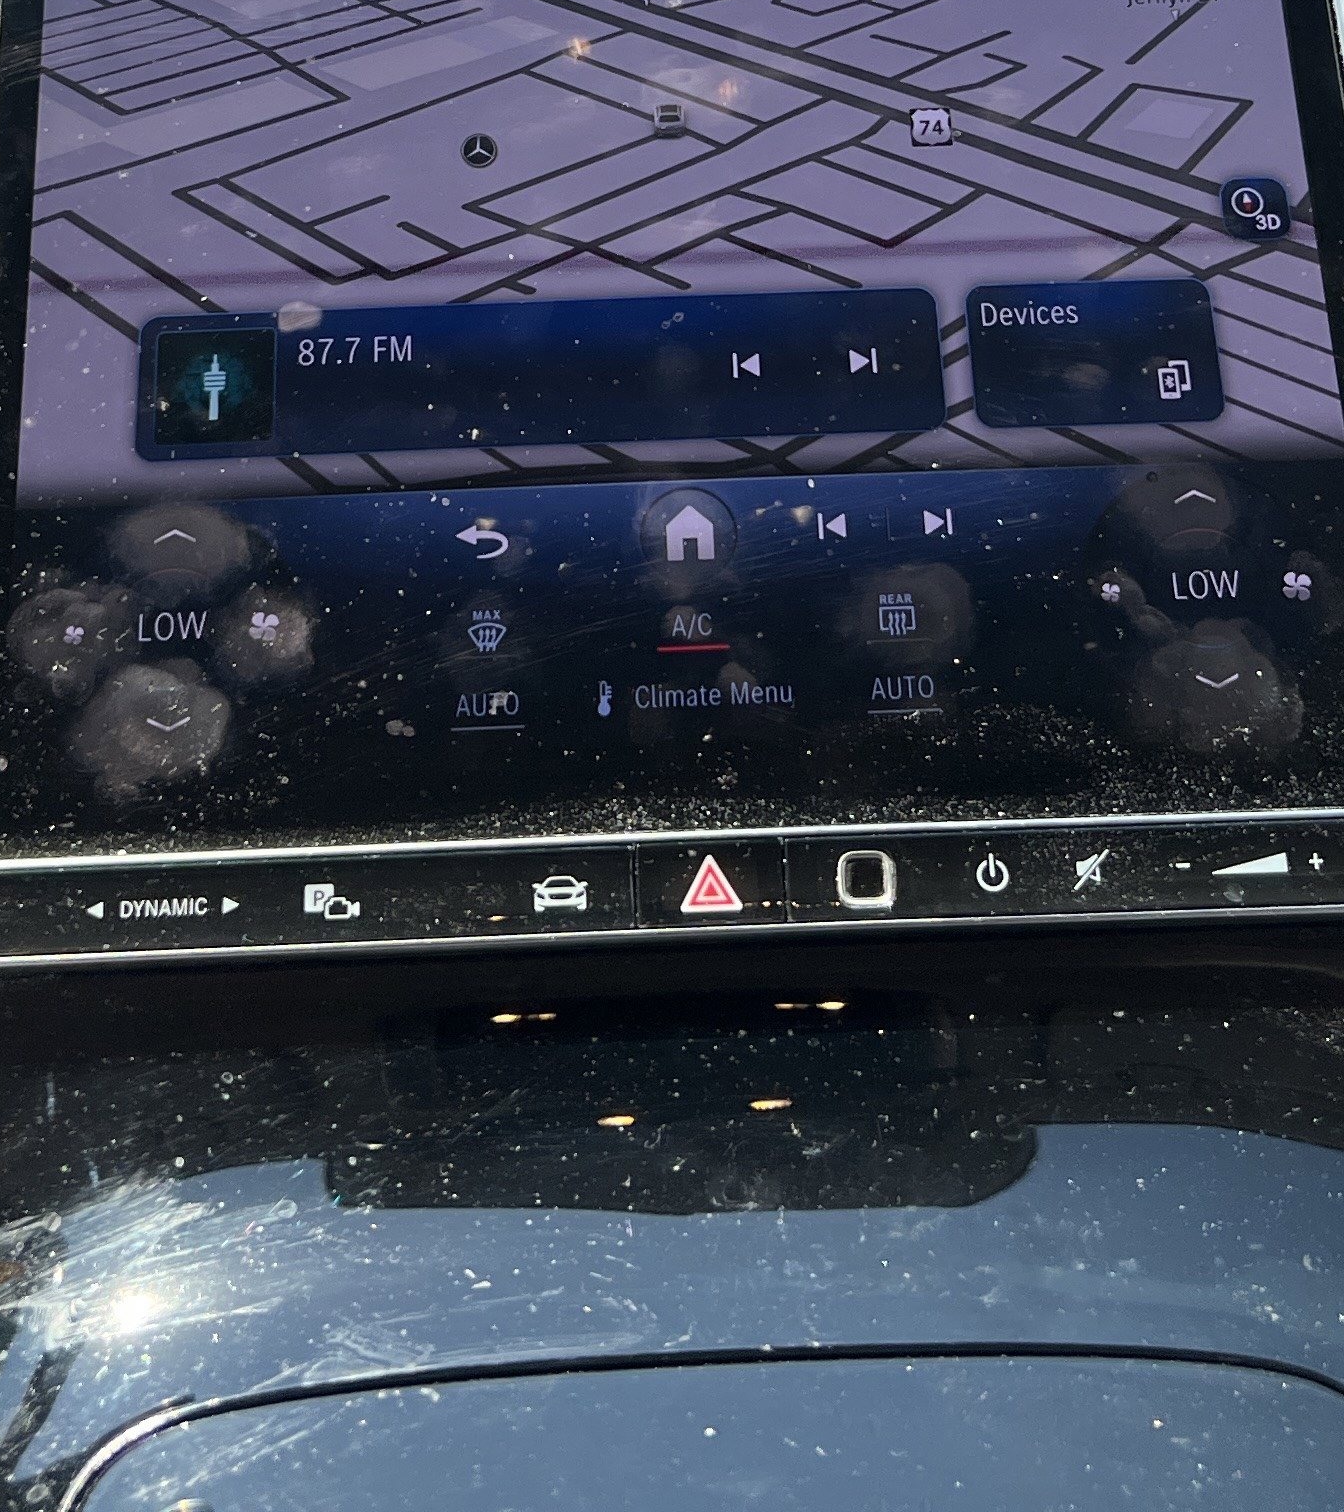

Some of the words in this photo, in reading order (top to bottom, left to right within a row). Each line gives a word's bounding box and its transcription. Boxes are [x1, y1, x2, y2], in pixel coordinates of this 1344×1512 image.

[919, 119, 944, 136] 74
[1255, 213, 1281, 231] 3D
[980, 300, 1079, 327] Devices
[298, 336, 361, 367] 87.7
[373, 335, 412, 363] FM
[1171, 569, 1239, 600] LOW
[879, 593, 913, 605] REAR
[138, 610, 207, 642] LOW
[472, 609, 502, 620] MAX
[671, 613, 713, 640] A/C
[635, 684, 722, 709] Climate
[730, 681, 793, 706] Menu
[871, 674, 935, 700] AUTO
[456, 691, 520, 718] AUTO
[119, 896, 208, 919] DYNAMIC
